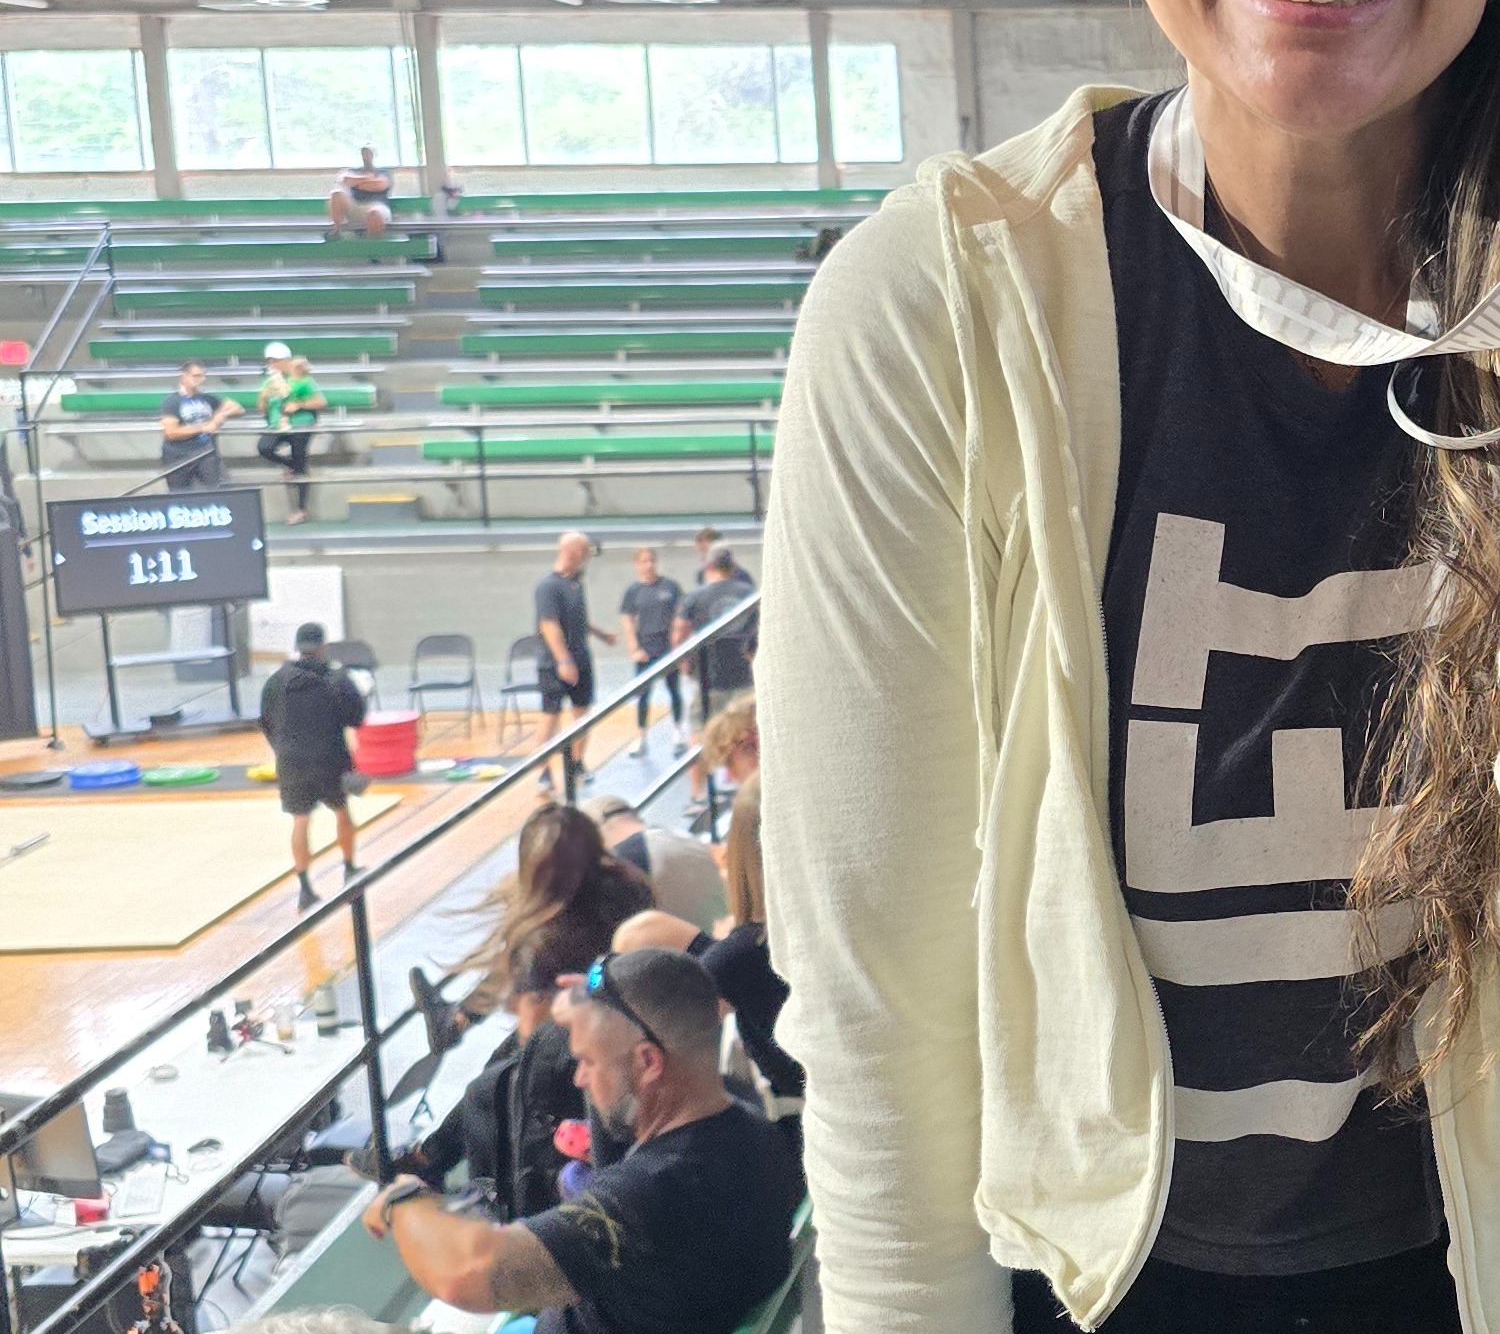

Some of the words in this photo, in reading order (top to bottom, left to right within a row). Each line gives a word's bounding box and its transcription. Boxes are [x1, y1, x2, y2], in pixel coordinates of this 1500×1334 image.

[81, 506, 167, 535] Session
[167, 503, 233, 529] Starts
[128, 547, 198, 585] 1:11
